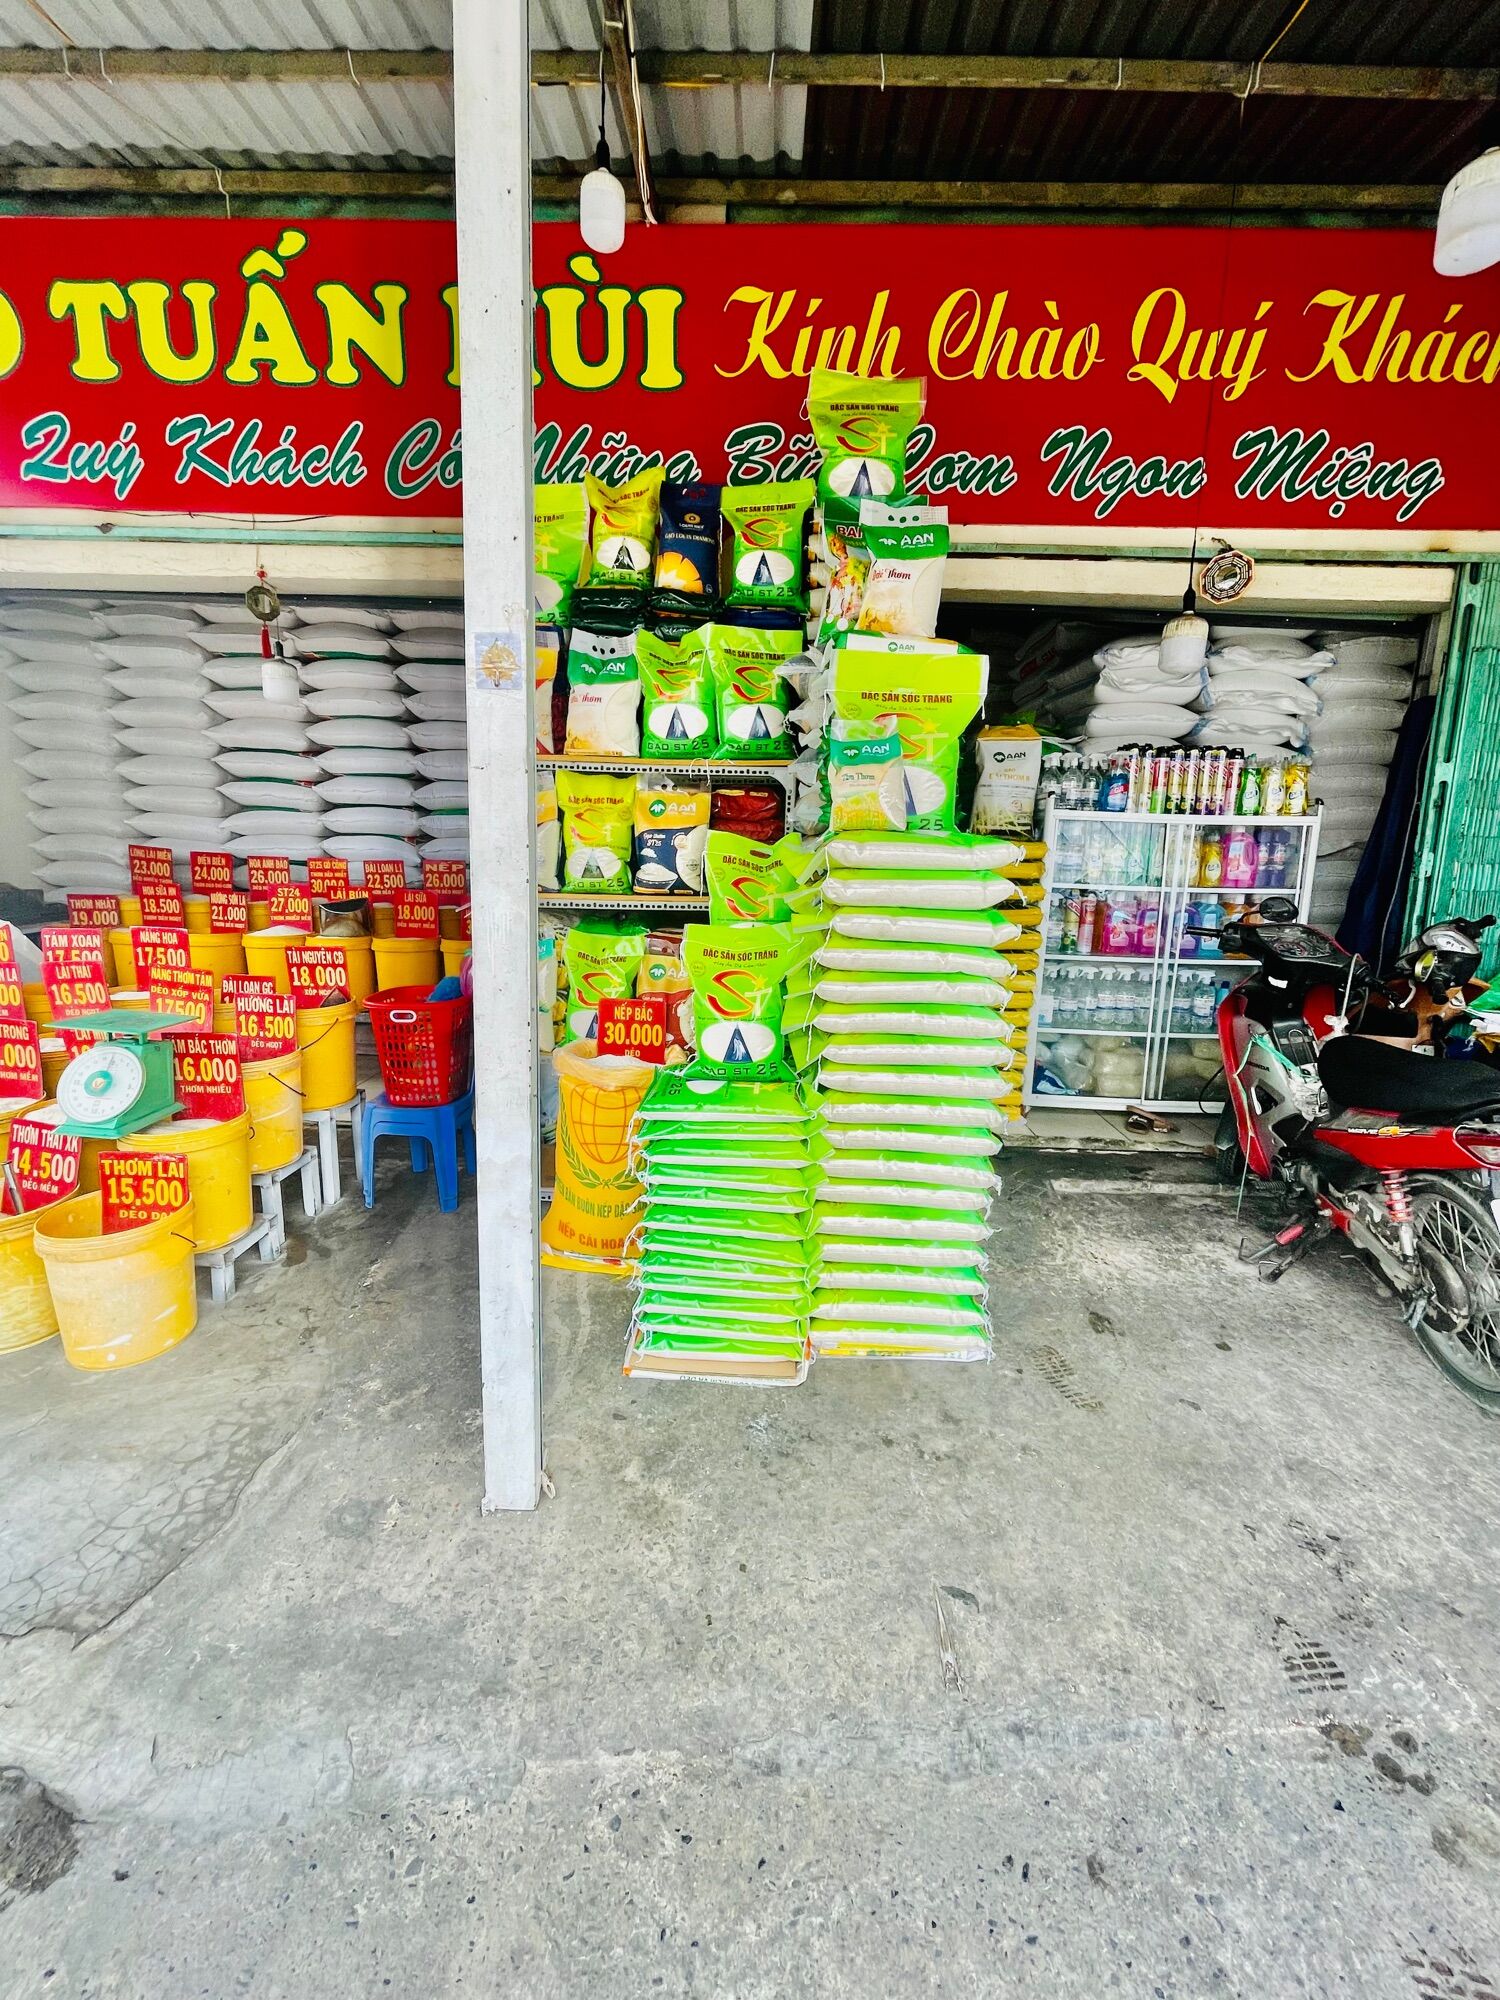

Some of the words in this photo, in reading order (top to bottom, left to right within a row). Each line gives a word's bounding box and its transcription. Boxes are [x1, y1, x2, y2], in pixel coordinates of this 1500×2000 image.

[48, 227, 409, 388] TUẤN
[439, 252, 687, 391] ÙI
[713, 285, 907, 379] Kính
[928, 285, 1107, 382] Chào
[1126, 285, 1277, 404] Quý
[20, 410, 144, 500] Quý
[165, 413, 367, 488] Khách
[384, 418, 462, 499] Có
[724, 422, 824, 487] Bữ
[1041, 426, 1206, 520] Ngon
[1232, 425, 1446, 520] Miệng
[901, 533, 934, 545] AAN
[759, 589, 773, 597] ST
[546, 611, 569, 623] 25
[673, 742, 689, 751] ST
[691, 739, 711, 751] 25
[861, 743, 890, 755] AAN
[1006, 751, 1026, 759] AAN
[918, 818, 945, 831] 25
[133, 860, 171, 878] 23.000
[194, 866, 231, 881] 24.000
[425, 860, 465, 872] NẾP
[250, 869, 289, 884] 26.000
[367, 873, 404, 890] 22.500
[425, 873, 465, 888] 26.000
[589, 881, 603, 889] ST
[606, 878, 625, 889] 25
[277, 887, 300, 897] ST24
[143, 898, 180, 914] 18.500
[211, 905, 247, 921] 21.000
[270, 897, 309, 914] 27.000
[397, 904, 435, 921] 18.000
[71, 910, 119, 926] 19.000
[71, 934, 101, 948] XOAN
[140, 926, 161, 944] NÀNG
[161, 931, 178, 945] HOA
[287, 947, 300, 964] TÀI
[301, 947, 332, 965] NGUYÊN
[172, 968, 195, 985] THƠM
[195, 971, 213, 987] TÁM
[291, 965, 347, 987] 18.000
[51, 982, 106, 1006] 16.500
[151, 983, 169, 995] DẺO
[171, 985, 189, 998] XỐP
[222, 977, 237, 993] ĐÀI
[239, 981, 260, 994] LOAN
[237, 995, 274, 1014] HƯƠNG
[276, 994, 294, 1014] LÀI
[614, 1002, 633, 1020] NẾP
[634, 1001, 653, 1021] BẮC
[239, 1014, 295, 1039] 16.500
[604, 1022, 663, 1046] 30.000
[171, 1036, 187, 1054] ÁM
[188, 1034, 208, 1054] BẮC
[208, 1037, 237, 1055] THƠM
[624, 1047, 641, 1057] DẺO
[0, 1043, 37, 1070] .000
[0, 1070, 18, 1080] HƠM
[174, 1057, 237, 1083] 16.000
[733, 1066, 751, 1076] ST
[756, 1062, 778, 1075] 25
[180, 1083, 205, 1093] THƠM
[206, 1081, 232, 1094] NHIỀU
[12, 1123, 39, 1146] THƠM
[64, 1135, 80, 1152] XK
[12, 1146, 76, 1184] 14.500
[101, 1157, 153, 1177] THƠM
[22, 1178, 38, 1191] DẺO
[107, 1177, 183, 1207] 15.500
[119, 1206, 148, 1219] DẺO
[558, 1220, 575, 1240] NẾP
[579, 1233, 597, 1249] CÁI
[601, 1238, 625, 1250] HOA
